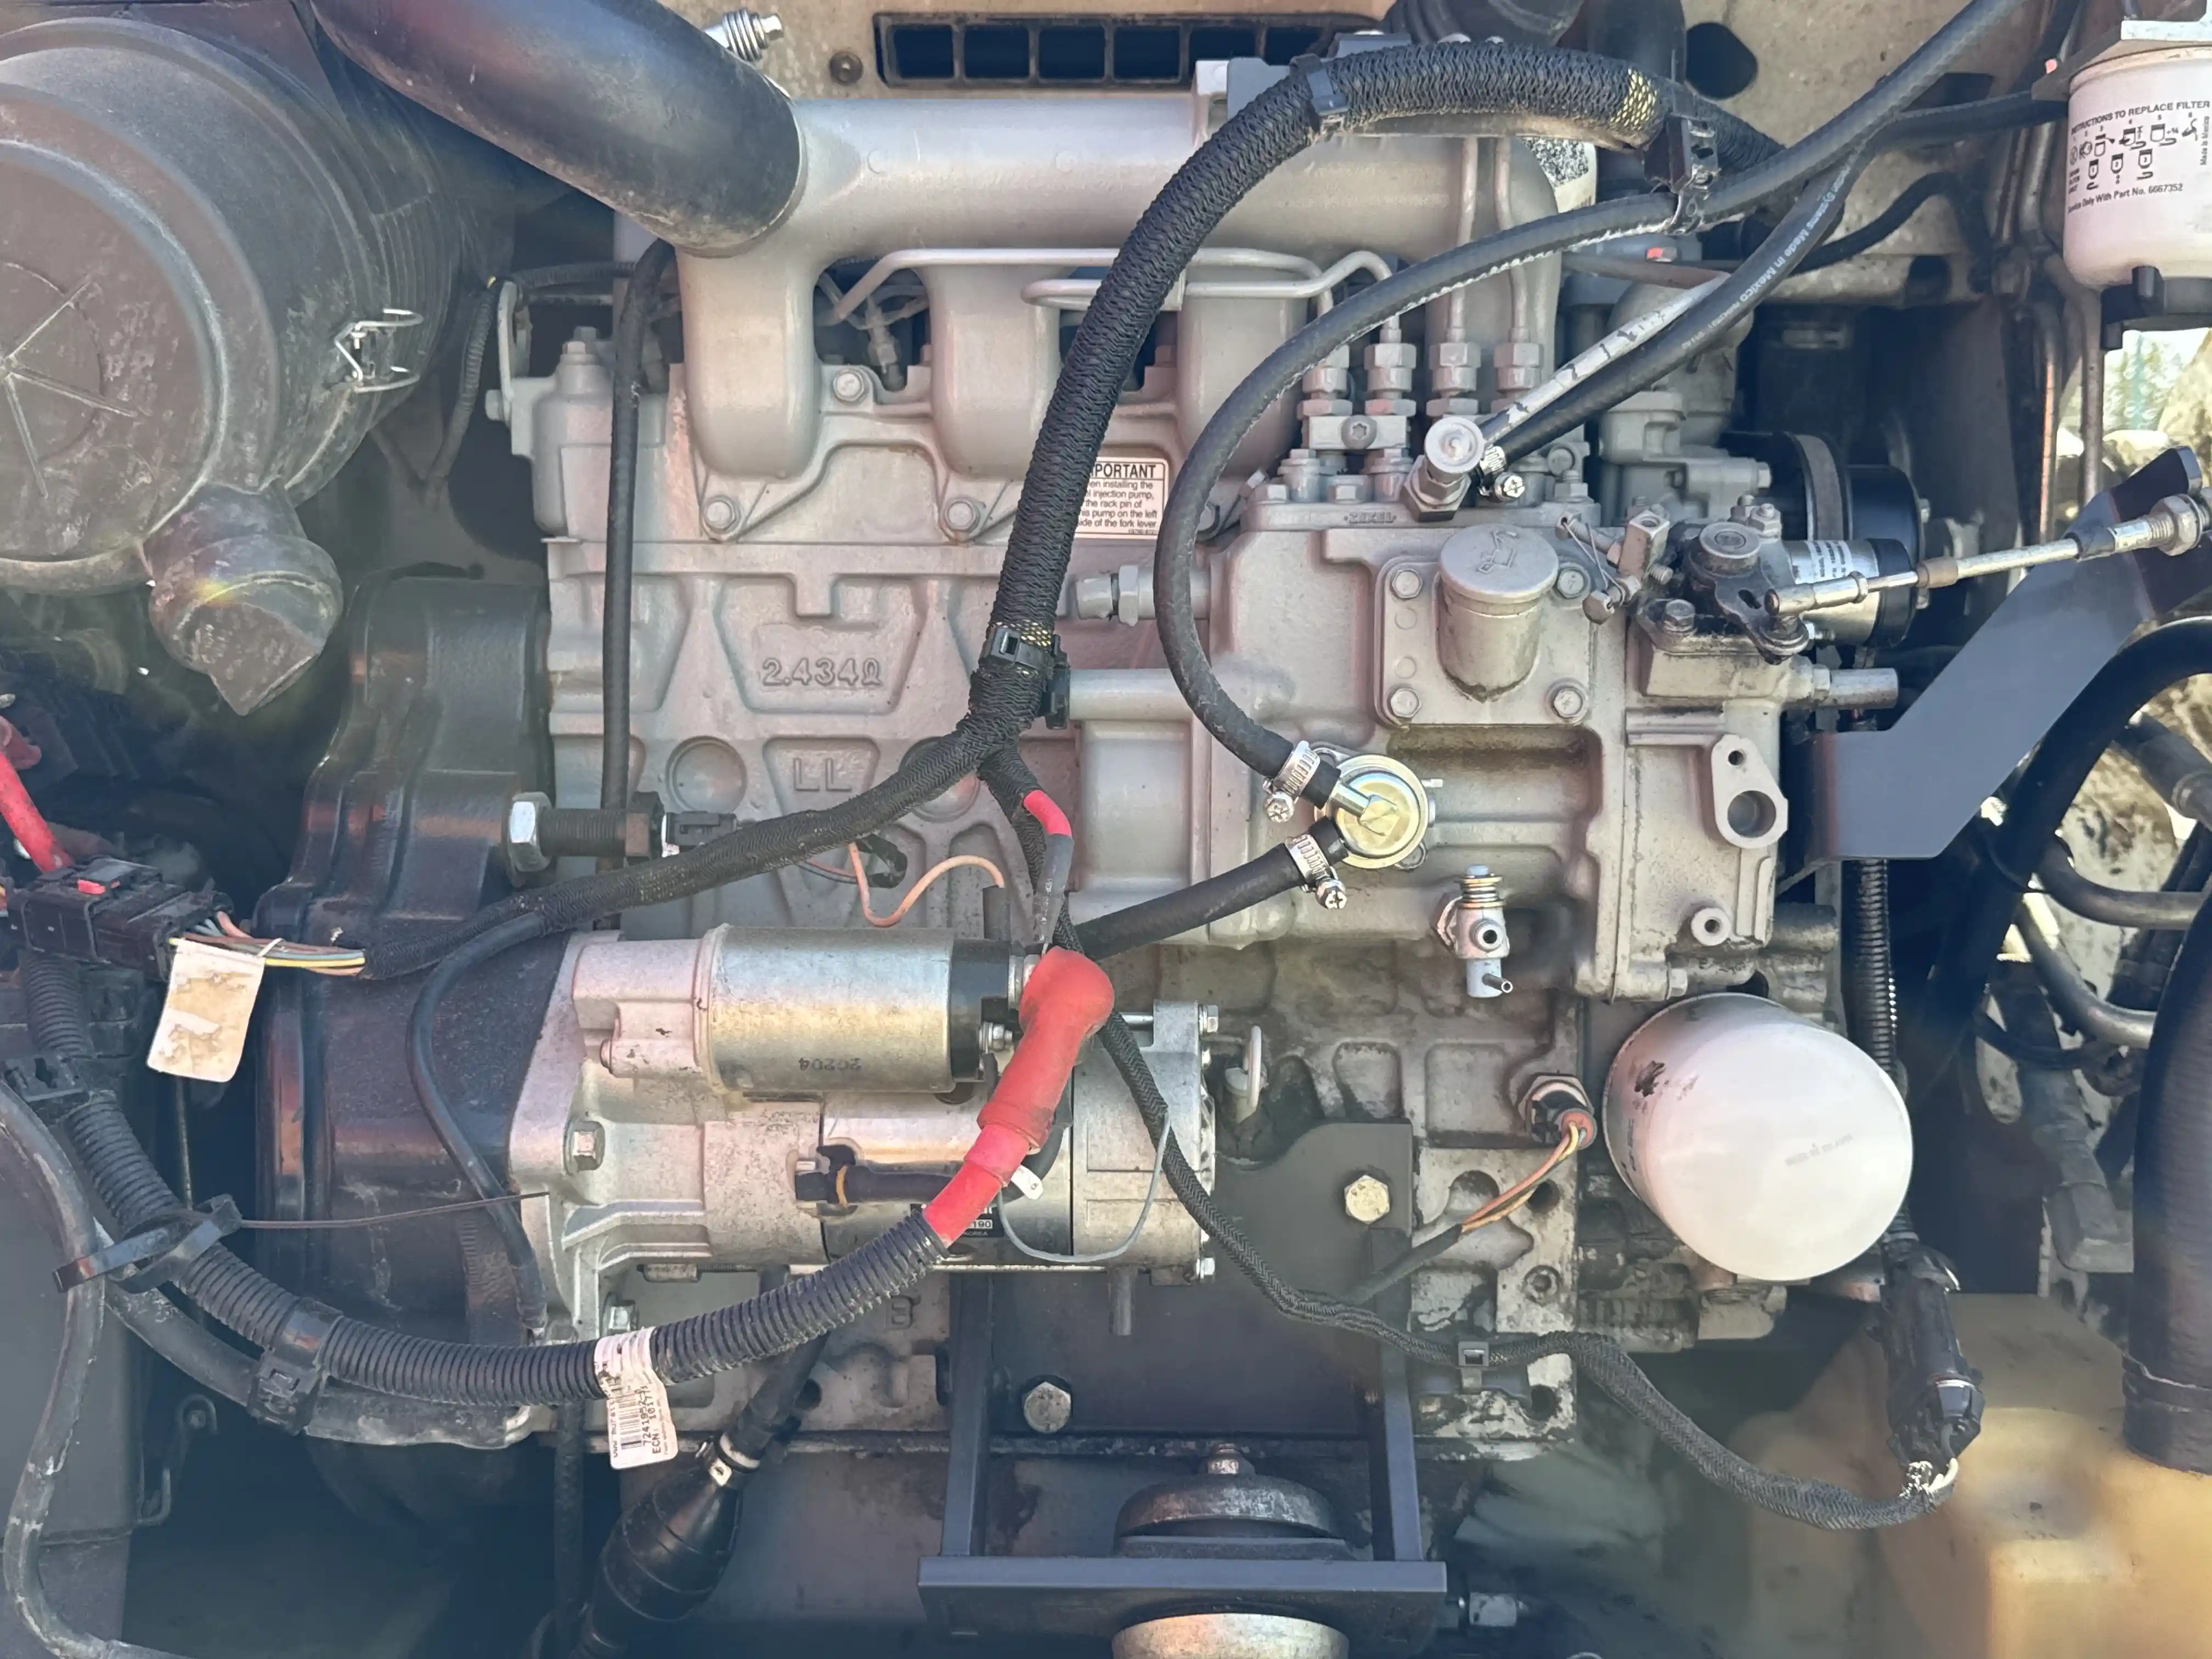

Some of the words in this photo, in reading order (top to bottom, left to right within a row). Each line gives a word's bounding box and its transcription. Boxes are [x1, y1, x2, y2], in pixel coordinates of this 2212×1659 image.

[2114, 110, 2126, 120] TO
[2128, 102, 2174, 116] REPLACE
[2176, 100, 2210, 110] FILTER
[2096, 193, 2112, 203] With
[2114, 189, 2130, 199] Part
[2132, 187, 2146, 195] No.
[1739, 267, 1777, 302] Mexico
[1091, 464, 1156, 478] PORTANT
[1140, 481, 1153, 489] the
[1093, 490, 1126, 499] injection
[1100, 500, 1118, 508] rack
[1120, 500, 1132, 510] pin
[1133, 500, 1143, 509] of
[1092, 510, 1116, 519] pump
[1130, 510, 1143, 518] the
[1094, 519, 1103, 527] of
[1105, 518, 1118, 528] the
[1119, 519, 1135, 528] fork
[793, 757, 853, 793] LL
